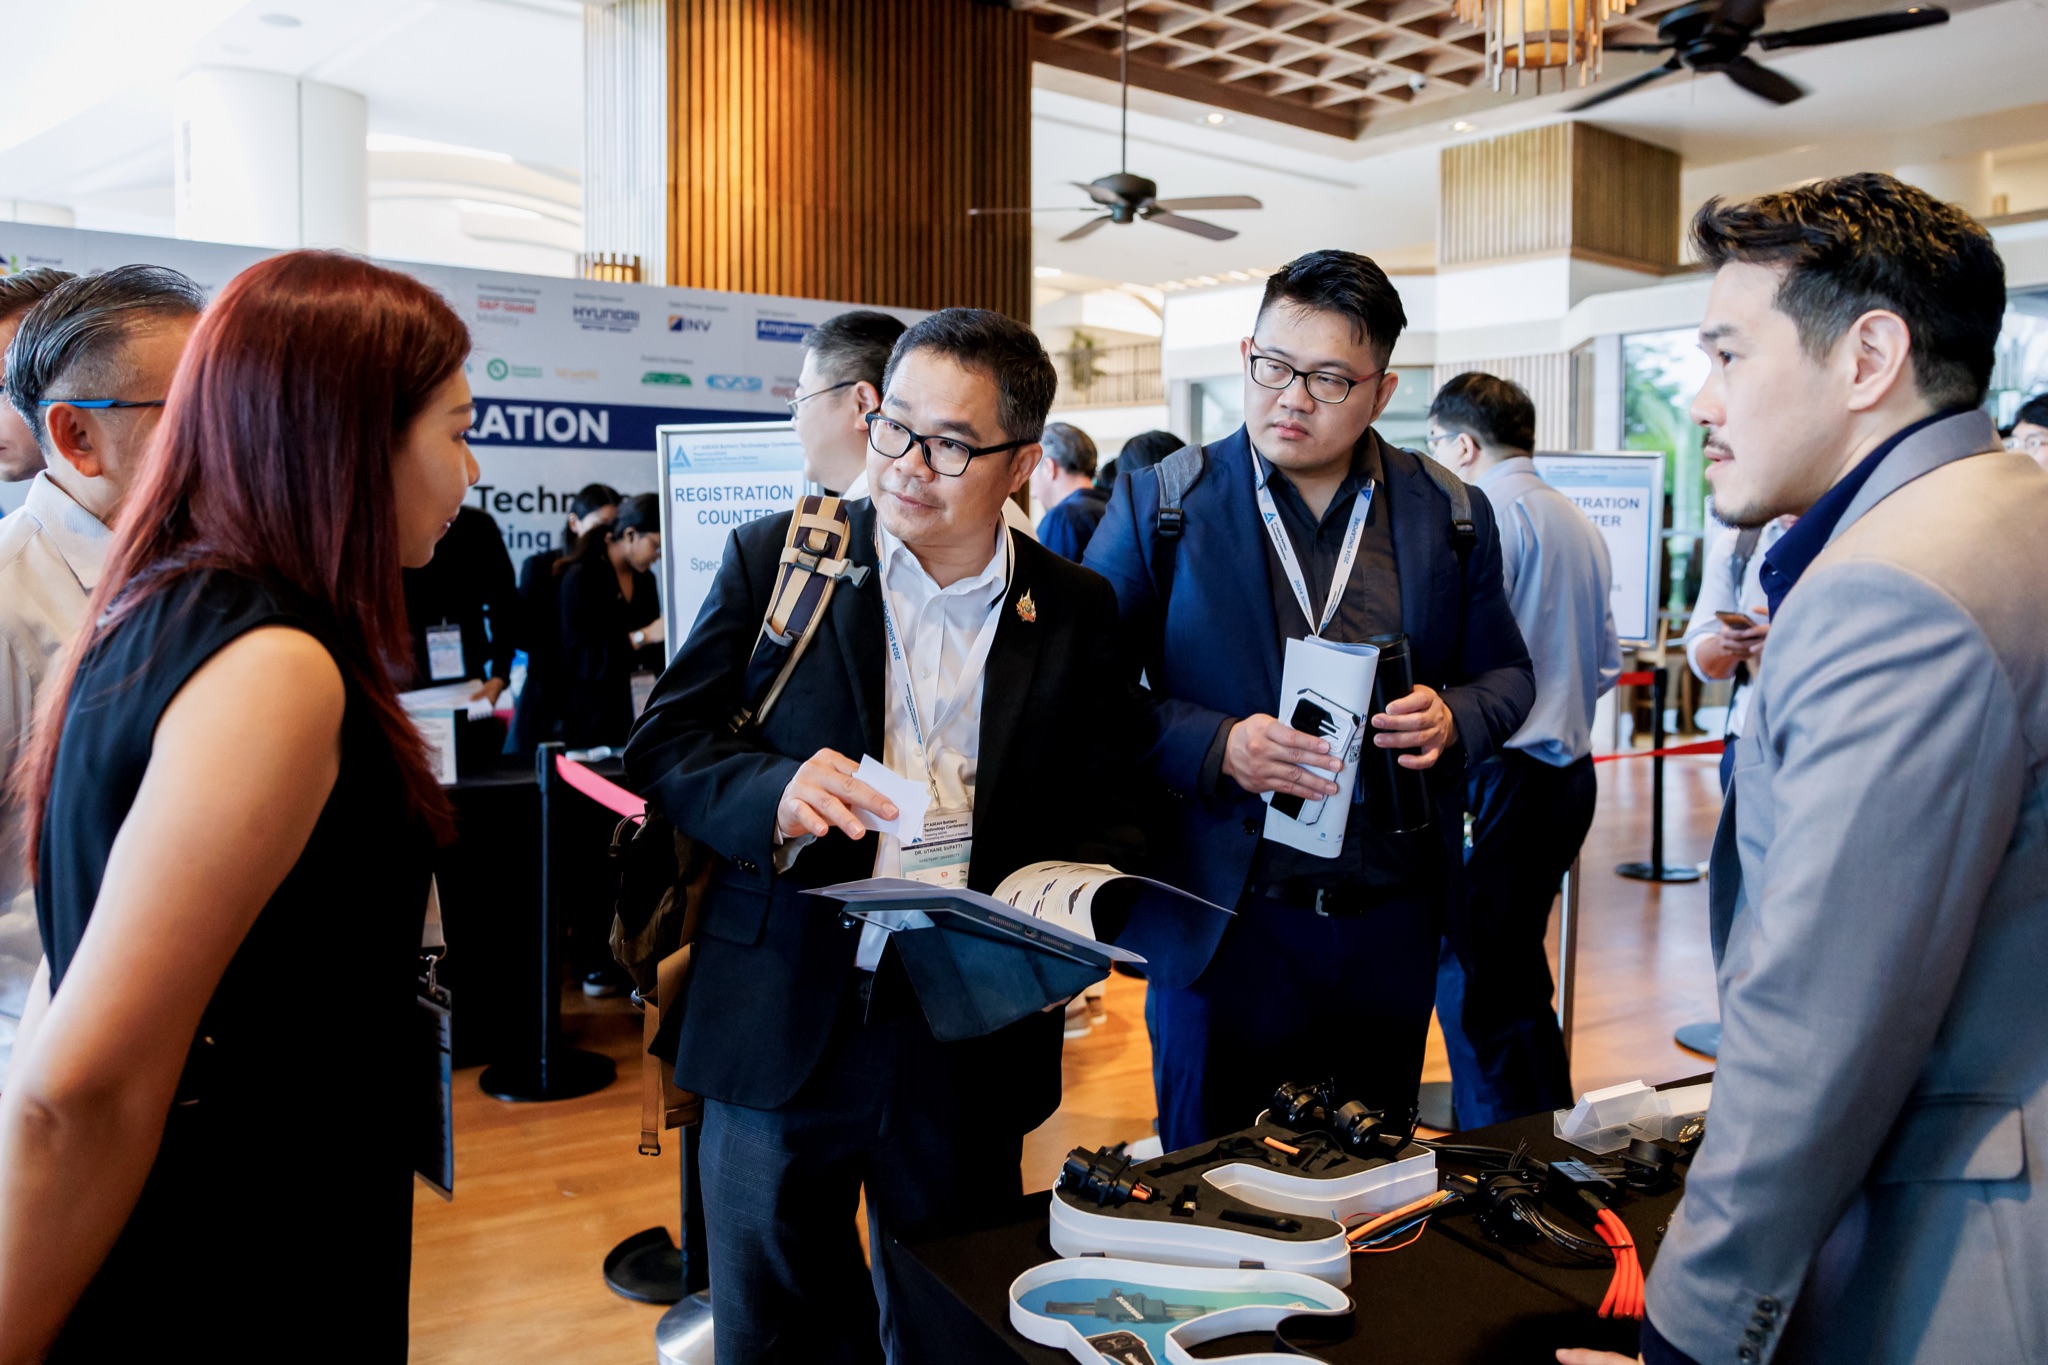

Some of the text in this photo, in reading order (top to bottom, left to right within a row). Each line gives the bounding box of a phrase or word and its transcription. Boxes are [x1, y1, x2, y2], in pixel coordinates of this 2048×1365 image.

[573, 306, 640, 321] HYUNDAI
[675, 485, 793, 502] REGISTRATION
[500, 525, 552, 552] ing
[1347, 517, 1361, 549] SINGAPORE
[890, 642, 901, 661] 2024
